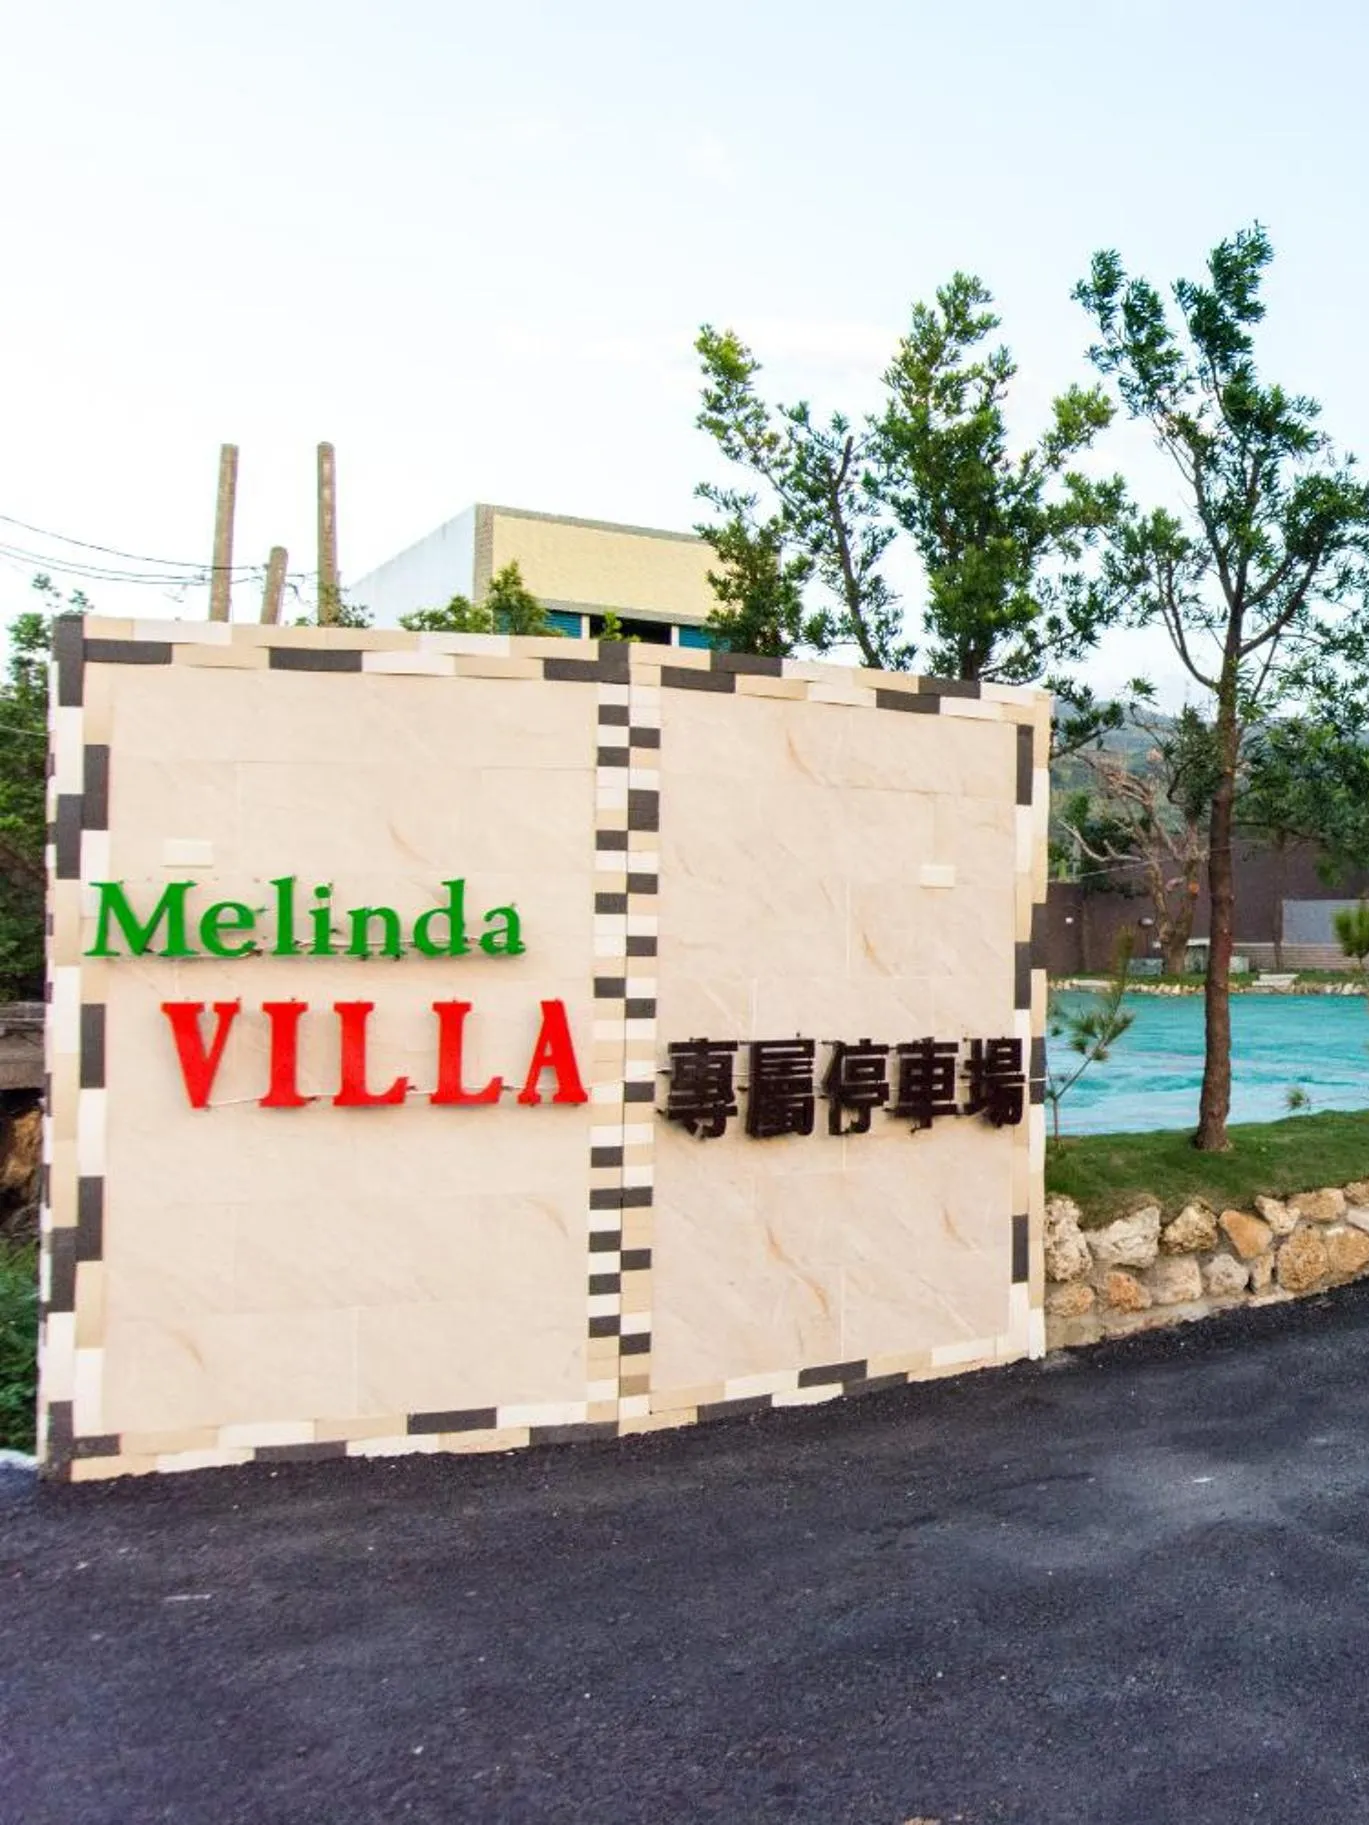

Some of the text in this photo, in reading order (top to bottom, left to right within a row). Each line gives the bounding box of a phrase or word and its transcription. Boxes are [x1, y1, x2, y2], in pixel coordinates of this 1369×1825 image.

[82, 875, 526, 958] Melinda
[159, 999, 589, 1109] VILLA
[665, 1037, 1026, 1138] 專屬停車場
